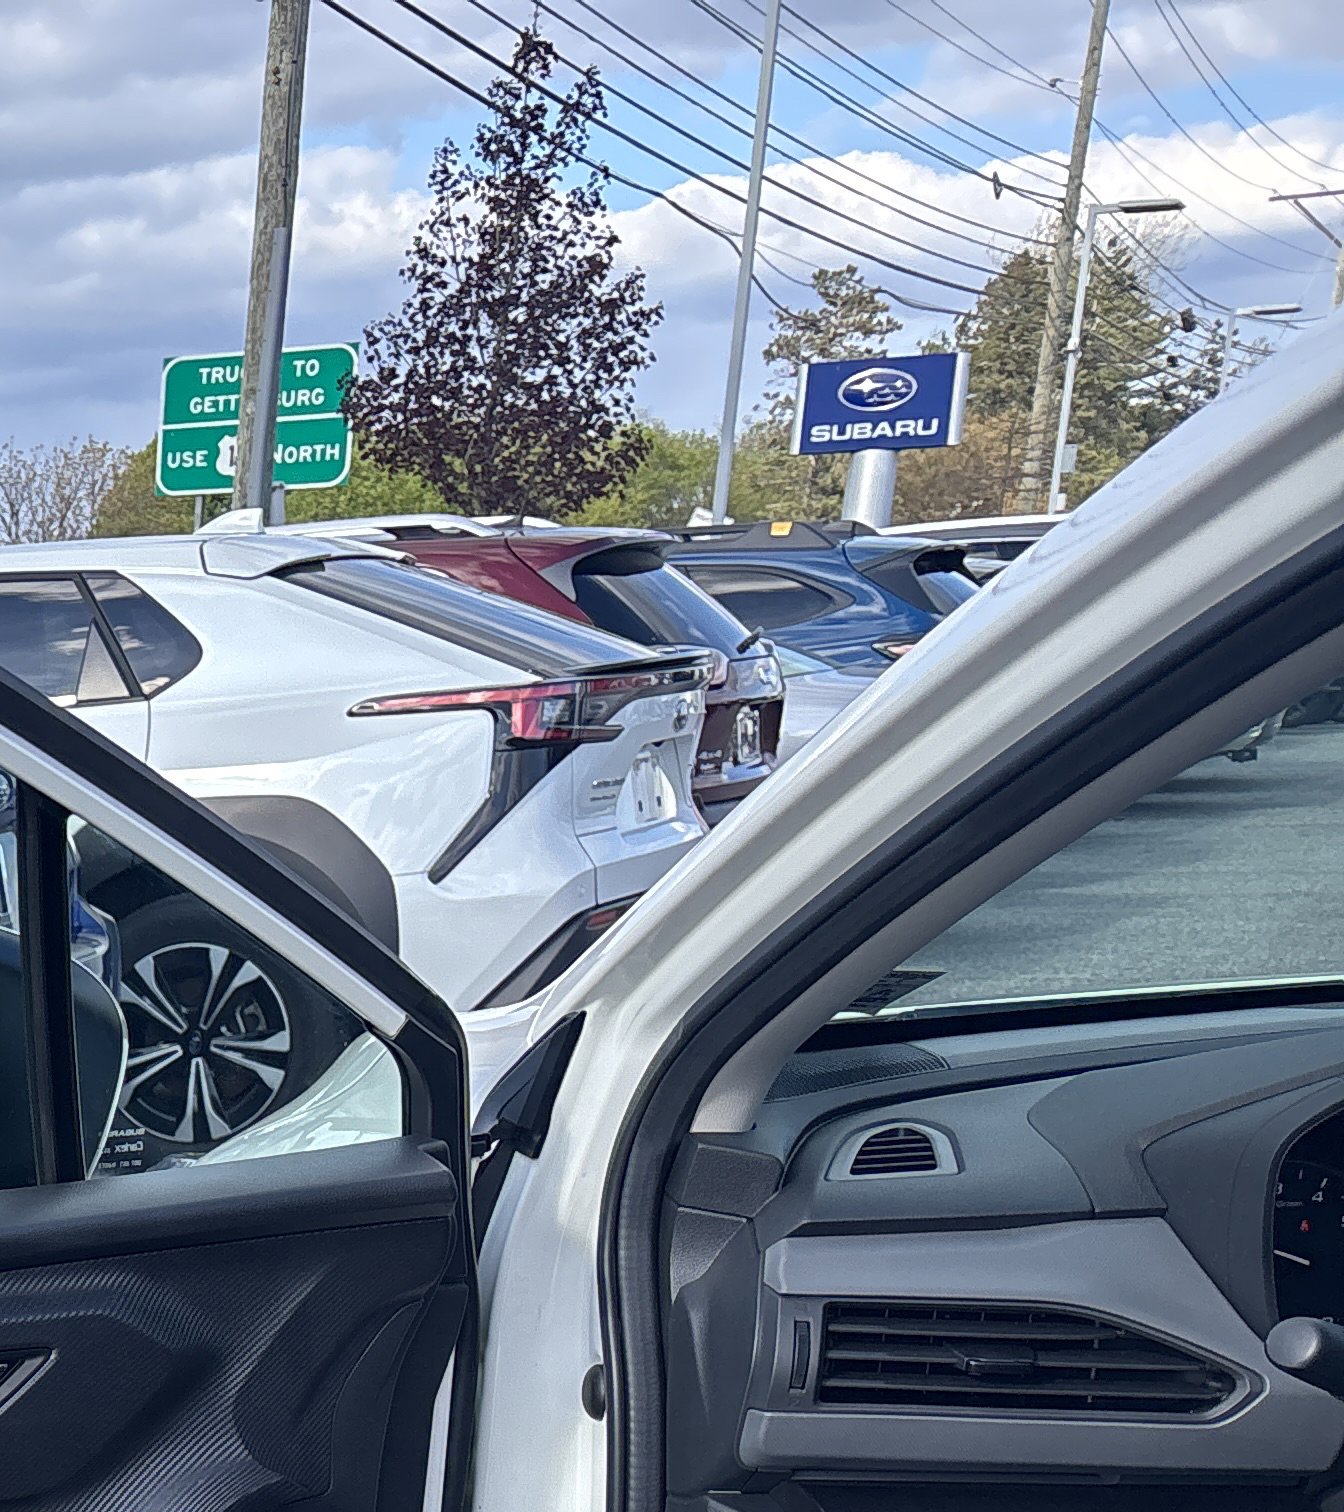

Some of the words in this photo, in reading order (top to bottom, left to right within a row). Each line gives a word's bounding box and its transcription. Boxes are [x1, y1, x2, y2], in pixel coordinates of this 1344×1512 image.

[199, 365, 245, 384] TRU
[293, 358, 320, 377] TO
[189, 387, 325, 414] GETTURG
[810, 418, 939, 442] SUBARU
[167, 450, 208, 468] USE
[1311, 1190, 1324, 1203] 4
